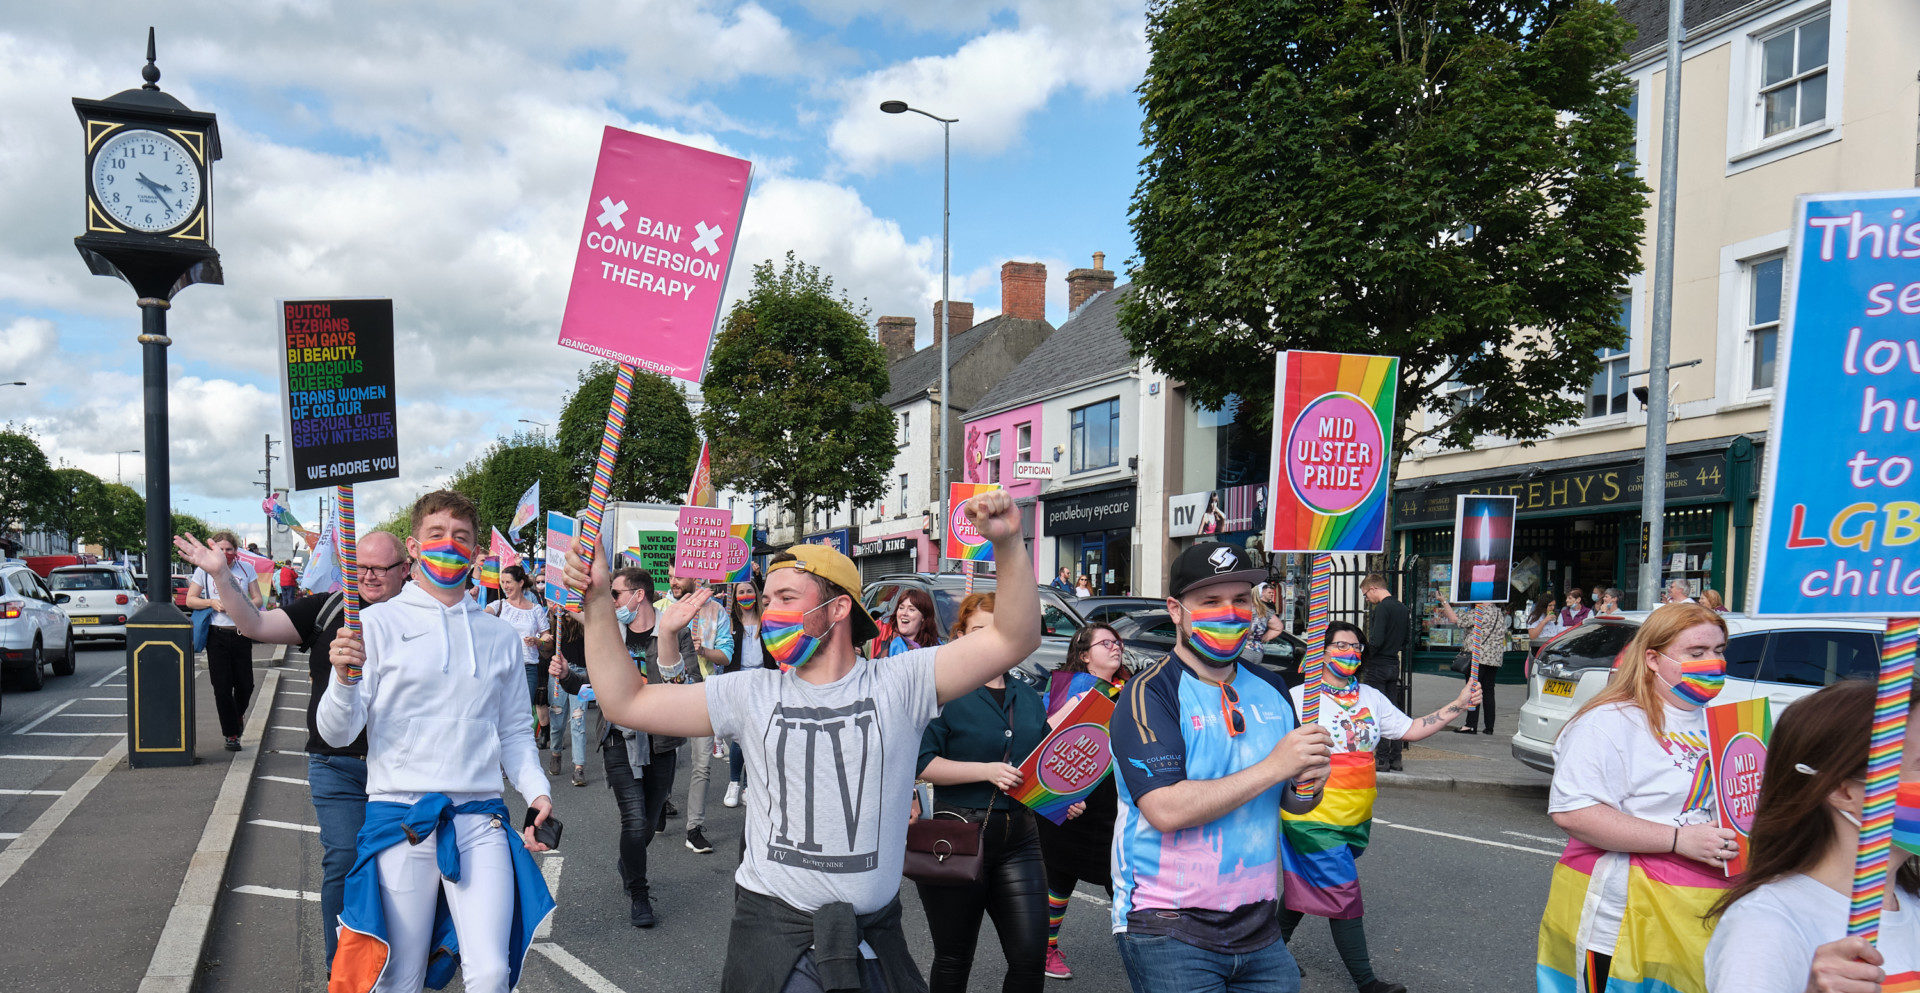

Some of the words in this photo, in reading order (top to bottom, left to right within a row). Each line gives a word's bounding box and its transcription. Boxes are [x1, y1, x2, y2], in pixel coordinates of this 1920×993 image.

[123, 147, 136, 158] 11
[141, 144, 155, 155] 12
[164, 151, 169, 161] 1
[111, 158, 125, 169] 10
[176, 164, 183, 175] 2
[107, 174, 114, 185] 9
[181, 182, 188, 192] 3
[113, 192, 120, 203] 8
[175, 199, 183, 208] 4
[125, 205, 133, 216] 7
[145, 213, 152, 223] 6
[164, 209, 171, 220] 5
[636, 216, 681, 244] BAN
[1809, 207, 1920, 261] This
[586, 231, 720, 282] CONVERSION
[601, 261, 696, 301] THERAPY
[285, 304, 331, 319] BUTCH
[286, 318, 349, 334] LEZBIANS
[287, 334, 318, 349] FEM
[320, 332, 356, 347] GAYS
[288, 348, 301, 363] BI
[303, 345, 356, 363] BEAUTY
[560, 337, 677, 375] #BANCONVERSIONTHERAPY
[289, 359, 363, 378] BODACIOUS
[289, 375, 344, 392] QUEERS
[290, 389, 336, 406] TRANS
[338, 385, 386, 402] WOMEN
[291, 405, 309, 420] OF
[313, 401, 362, 418] COLOUR
[293, 416, 352, 434] ASEXUAL
[354, 412, 391, 428] CUTIE
[1318, 416, 1355, 439] MID
[293, 431, 329, 448] SEXY
[332, 425, 394, 445] INTERSEX
[1298, 440, 1371, 464] ULSTER
[307, 465, 327, 479] WE
[329, 459, 371, 477] ADORE
[372, 456, 397, 471] YOU
[1018, 465, 1051, 475] OPTICIAN
[1696, 465, 1721, 486] 44
[1846, 449, 1913, 489] to
[1303, 465, 1362, 488] PRIDE
[1470, 472, 1620, 509] EEHY'S
[1049, 504, 1093, 527] pendlebury
[1093, 501, 1130, 520] eyecare
[1174, 504, 1196, 526] nv
[1401, 500, 1418, 516] 44
[686, 516, 690, 524] I
[693, 516, 722, 527] STAND
[646, 535, 660, 543] WE
[662, 535, 674, 543] DO
[681, 526, 706, 536] WITH
[709, 529, 727, 538] MID
[685, 538, 719, 548] ULSTER
[885, 539, 906, 552] KING
[681, 549, 707, 558] PRIDE
[710, 551, 722, 559] AS
[681, 560, 694, 568] AN
[697, 560, 720, 570] ALLY
[1074, 734, 1100, 756] MID
[1053, 739, 1098, 775] ULSTER
[1734, 753, 1756, 773] MID
[1045, 755, 1084, 785] PRIDE
[1726, 772, 1760, 797] ULSTE
